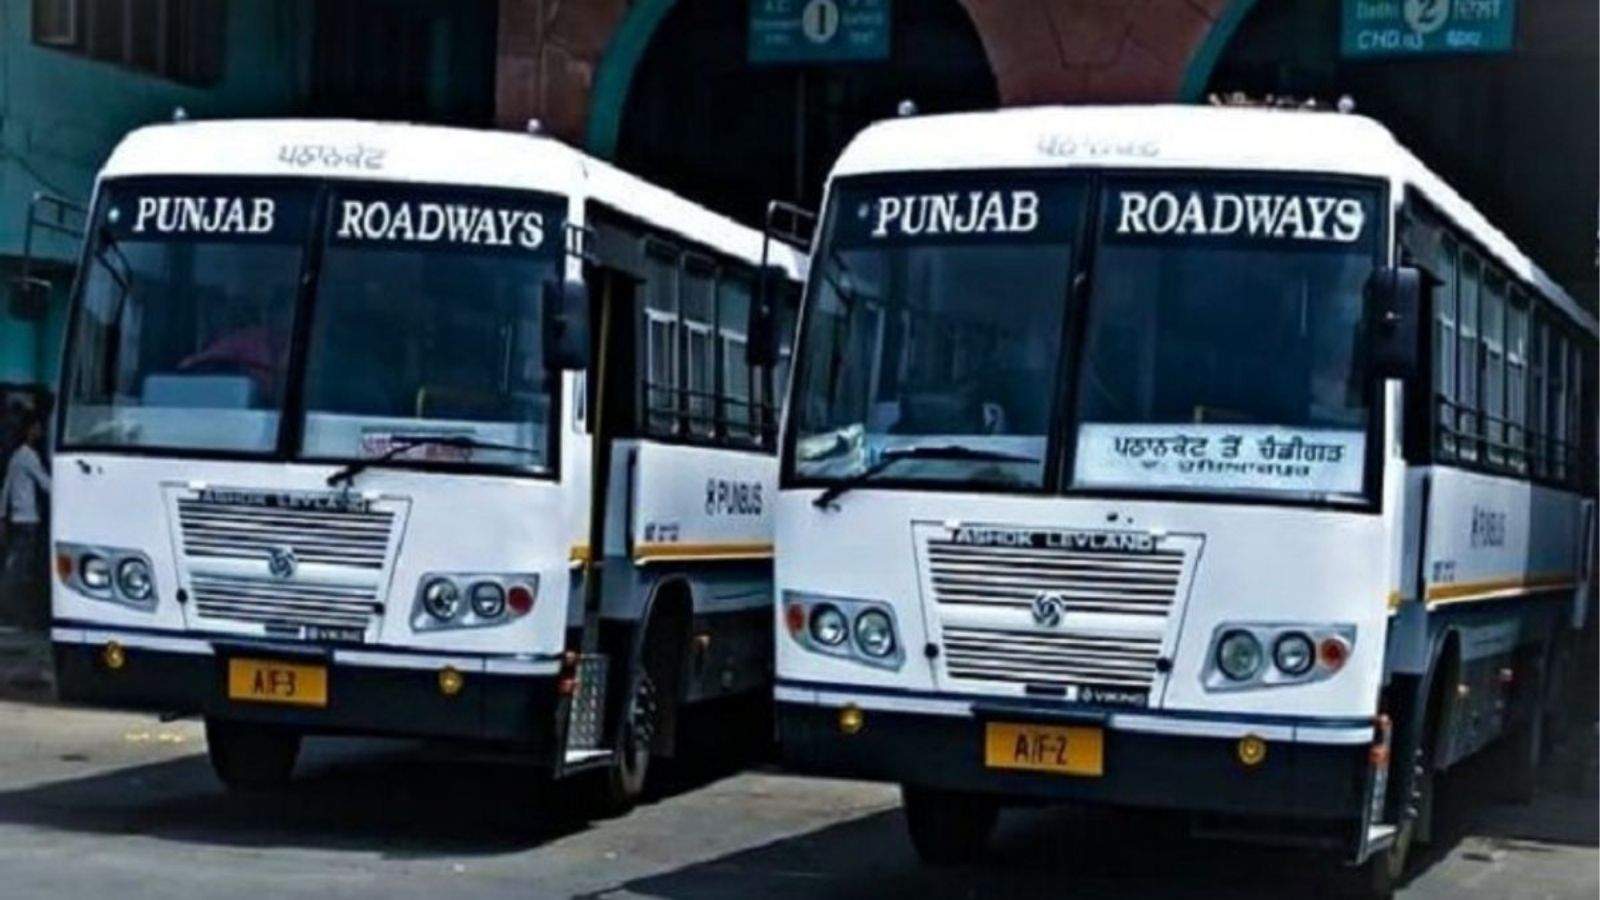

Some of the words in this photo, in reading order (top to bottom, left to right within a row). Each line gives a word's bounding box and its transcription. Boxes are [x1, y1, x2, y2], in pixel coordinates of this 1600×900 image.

[133, 196, 276, 234] PUNJAB
[337, 200, 545, 249] ROADWAYS
[871, 191, 1040, 238] PUNJAB
[1117, 191, 1365, 243] ROADWAYS
[954, 528, 1034, 548] ASHOK
[1046, 531, 1156, 551] LEYLAND
